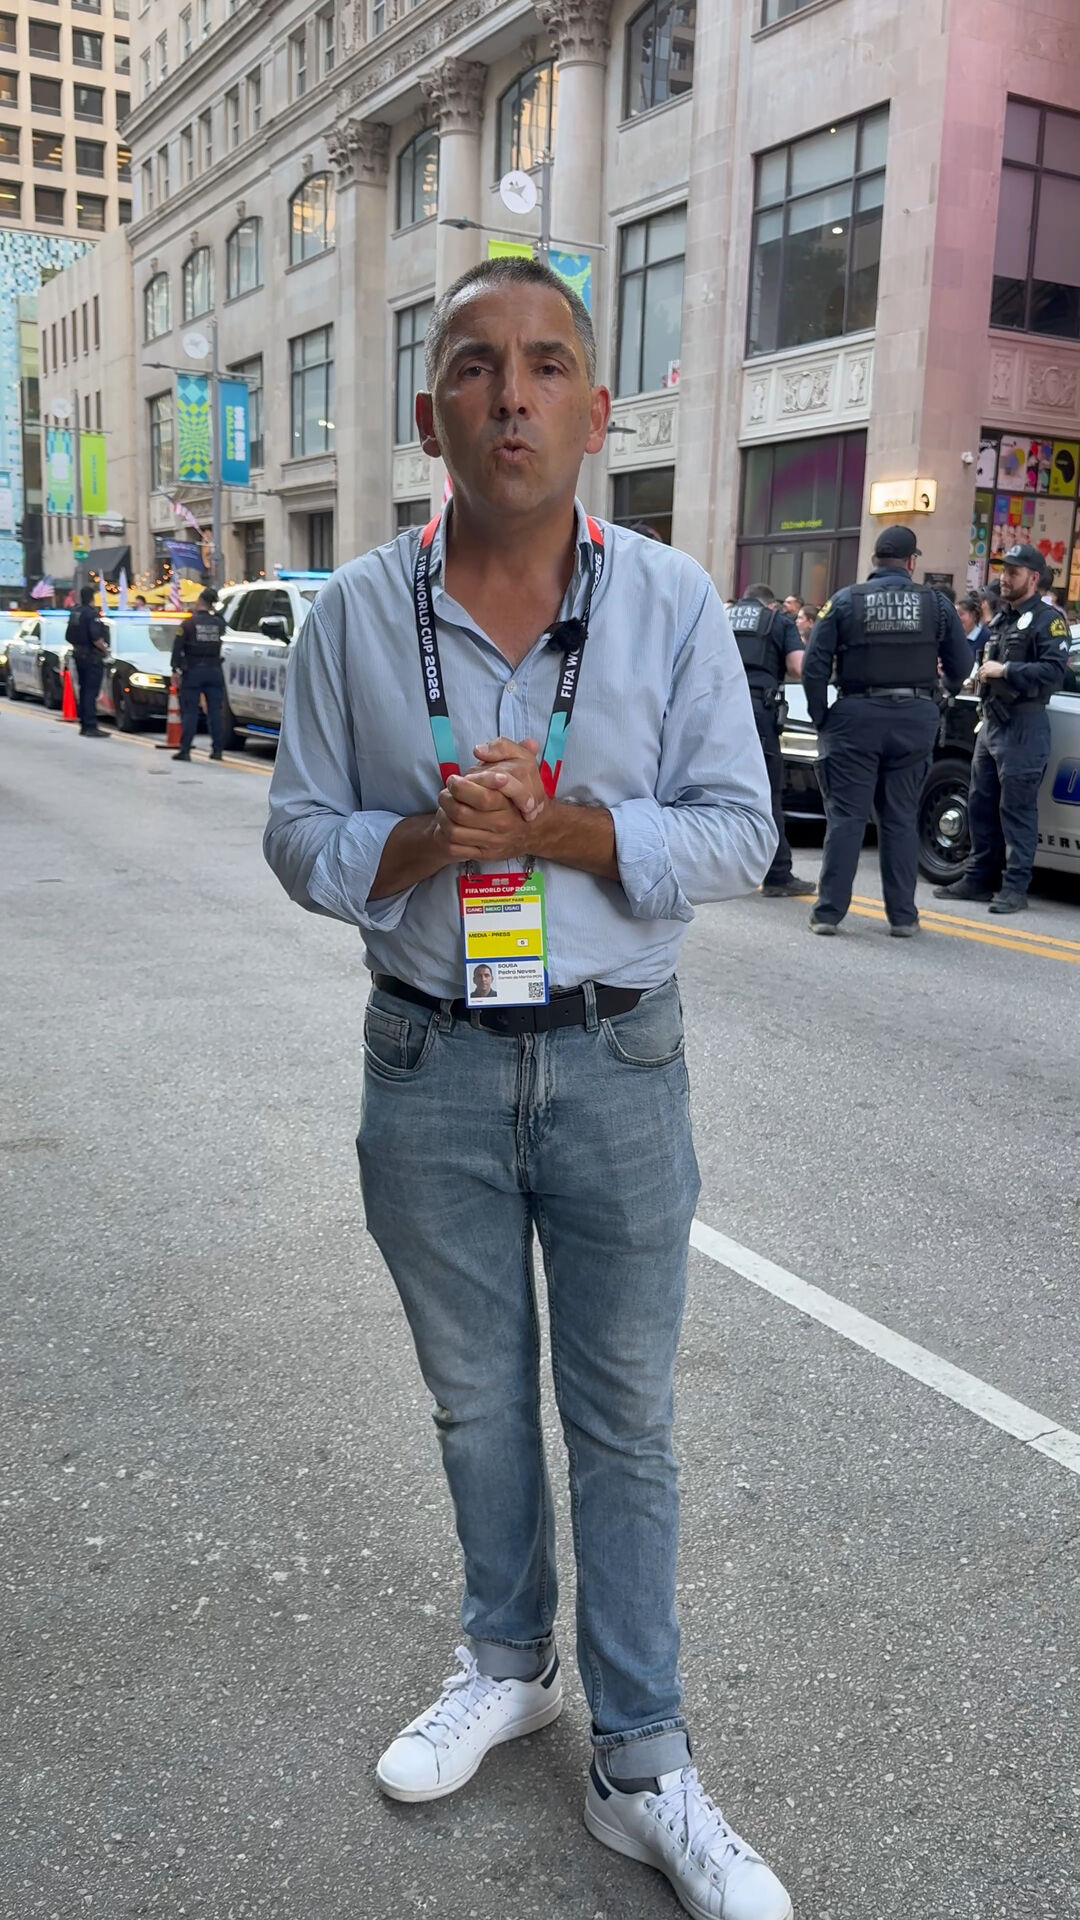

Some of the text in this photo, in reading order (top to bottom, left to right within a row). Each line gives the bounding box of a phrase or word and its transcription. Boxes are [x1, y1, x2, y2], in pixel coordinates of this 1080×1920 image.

[867, 592, 921, 606] DALLAS
[728, 606, 760, 618] LLAS
[867, 606, 921, 620] POLICE
[416, 555, 440, 700] FIFA WORLD CUP 2026
[229, 662, 276, 691] POLICE
[560, 669, 576, 698] FIFA
